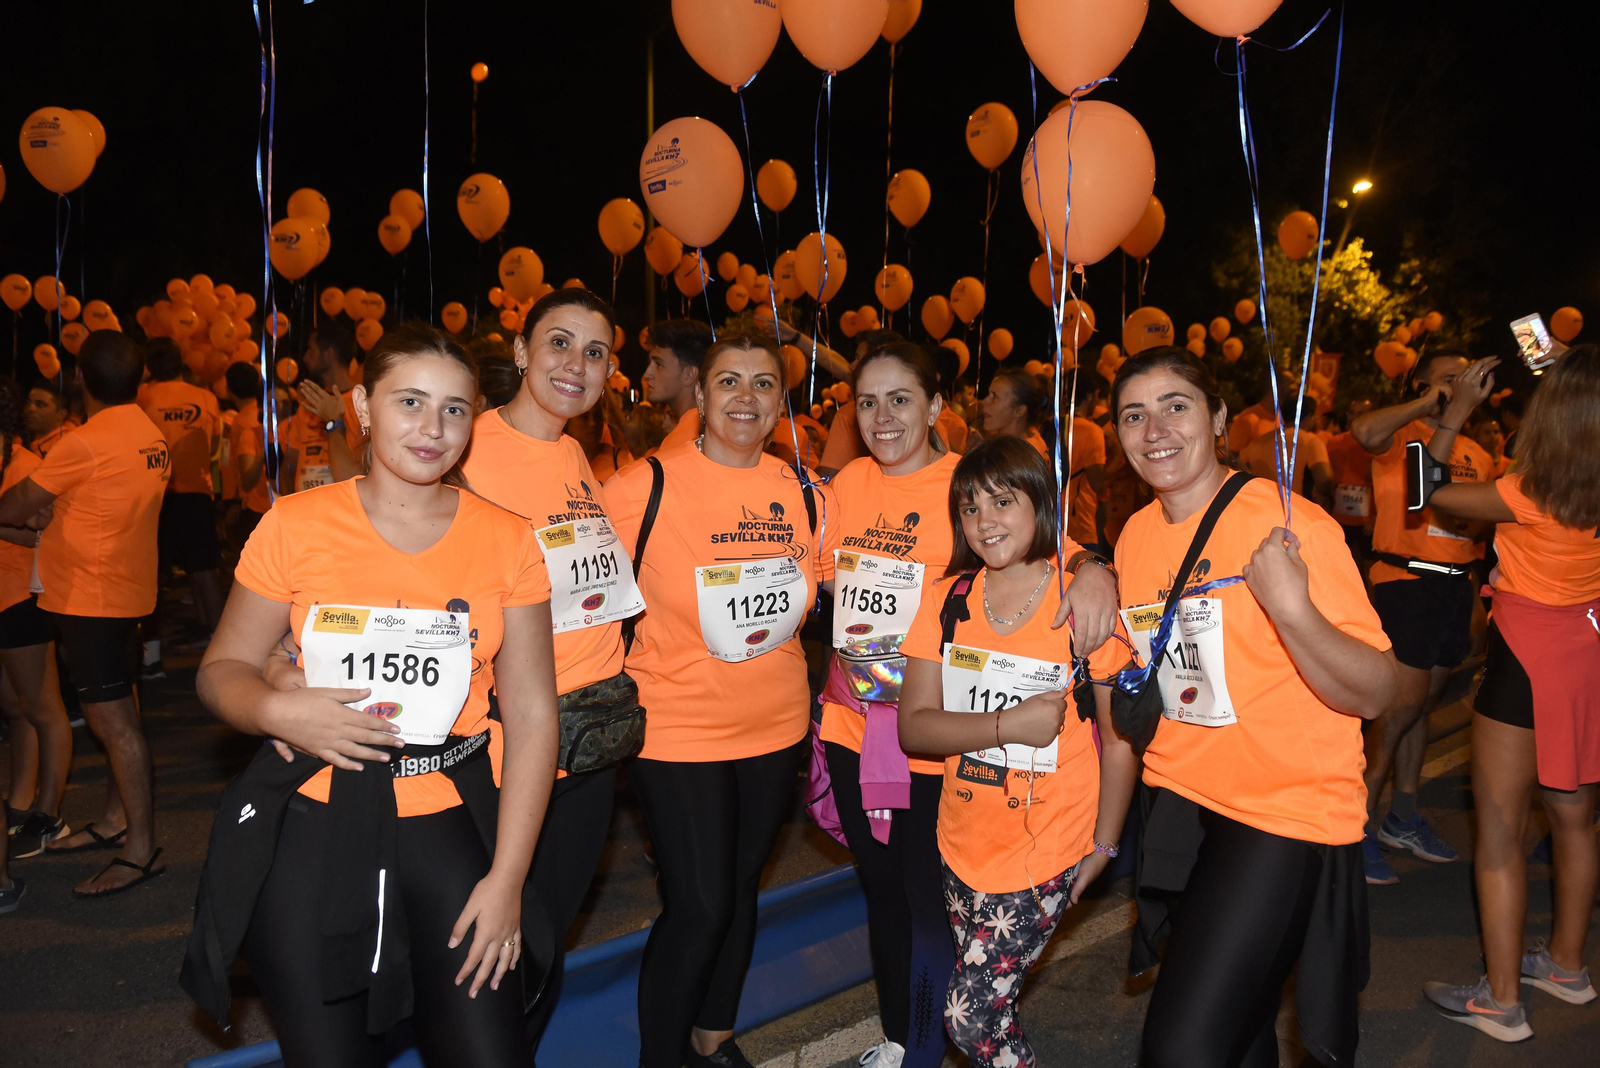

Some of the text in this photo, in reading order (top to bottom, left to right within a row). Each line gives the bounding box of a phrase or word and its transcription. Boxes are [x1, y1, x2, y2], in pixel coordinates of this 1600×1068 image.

[711, 532, 766, 543] SEVILLA
[738, 522, 793, 531] NOCTURNA
[863, 528, 917, 545] NOCTURNA
[842, 536, 883, 551] SEVILLA
[570, 551, 619, 585] 11191
[727, 591, 790, 621] 11223
[841, 584, 897, 616] 11583
[341, 652, 440, 687] 11586
